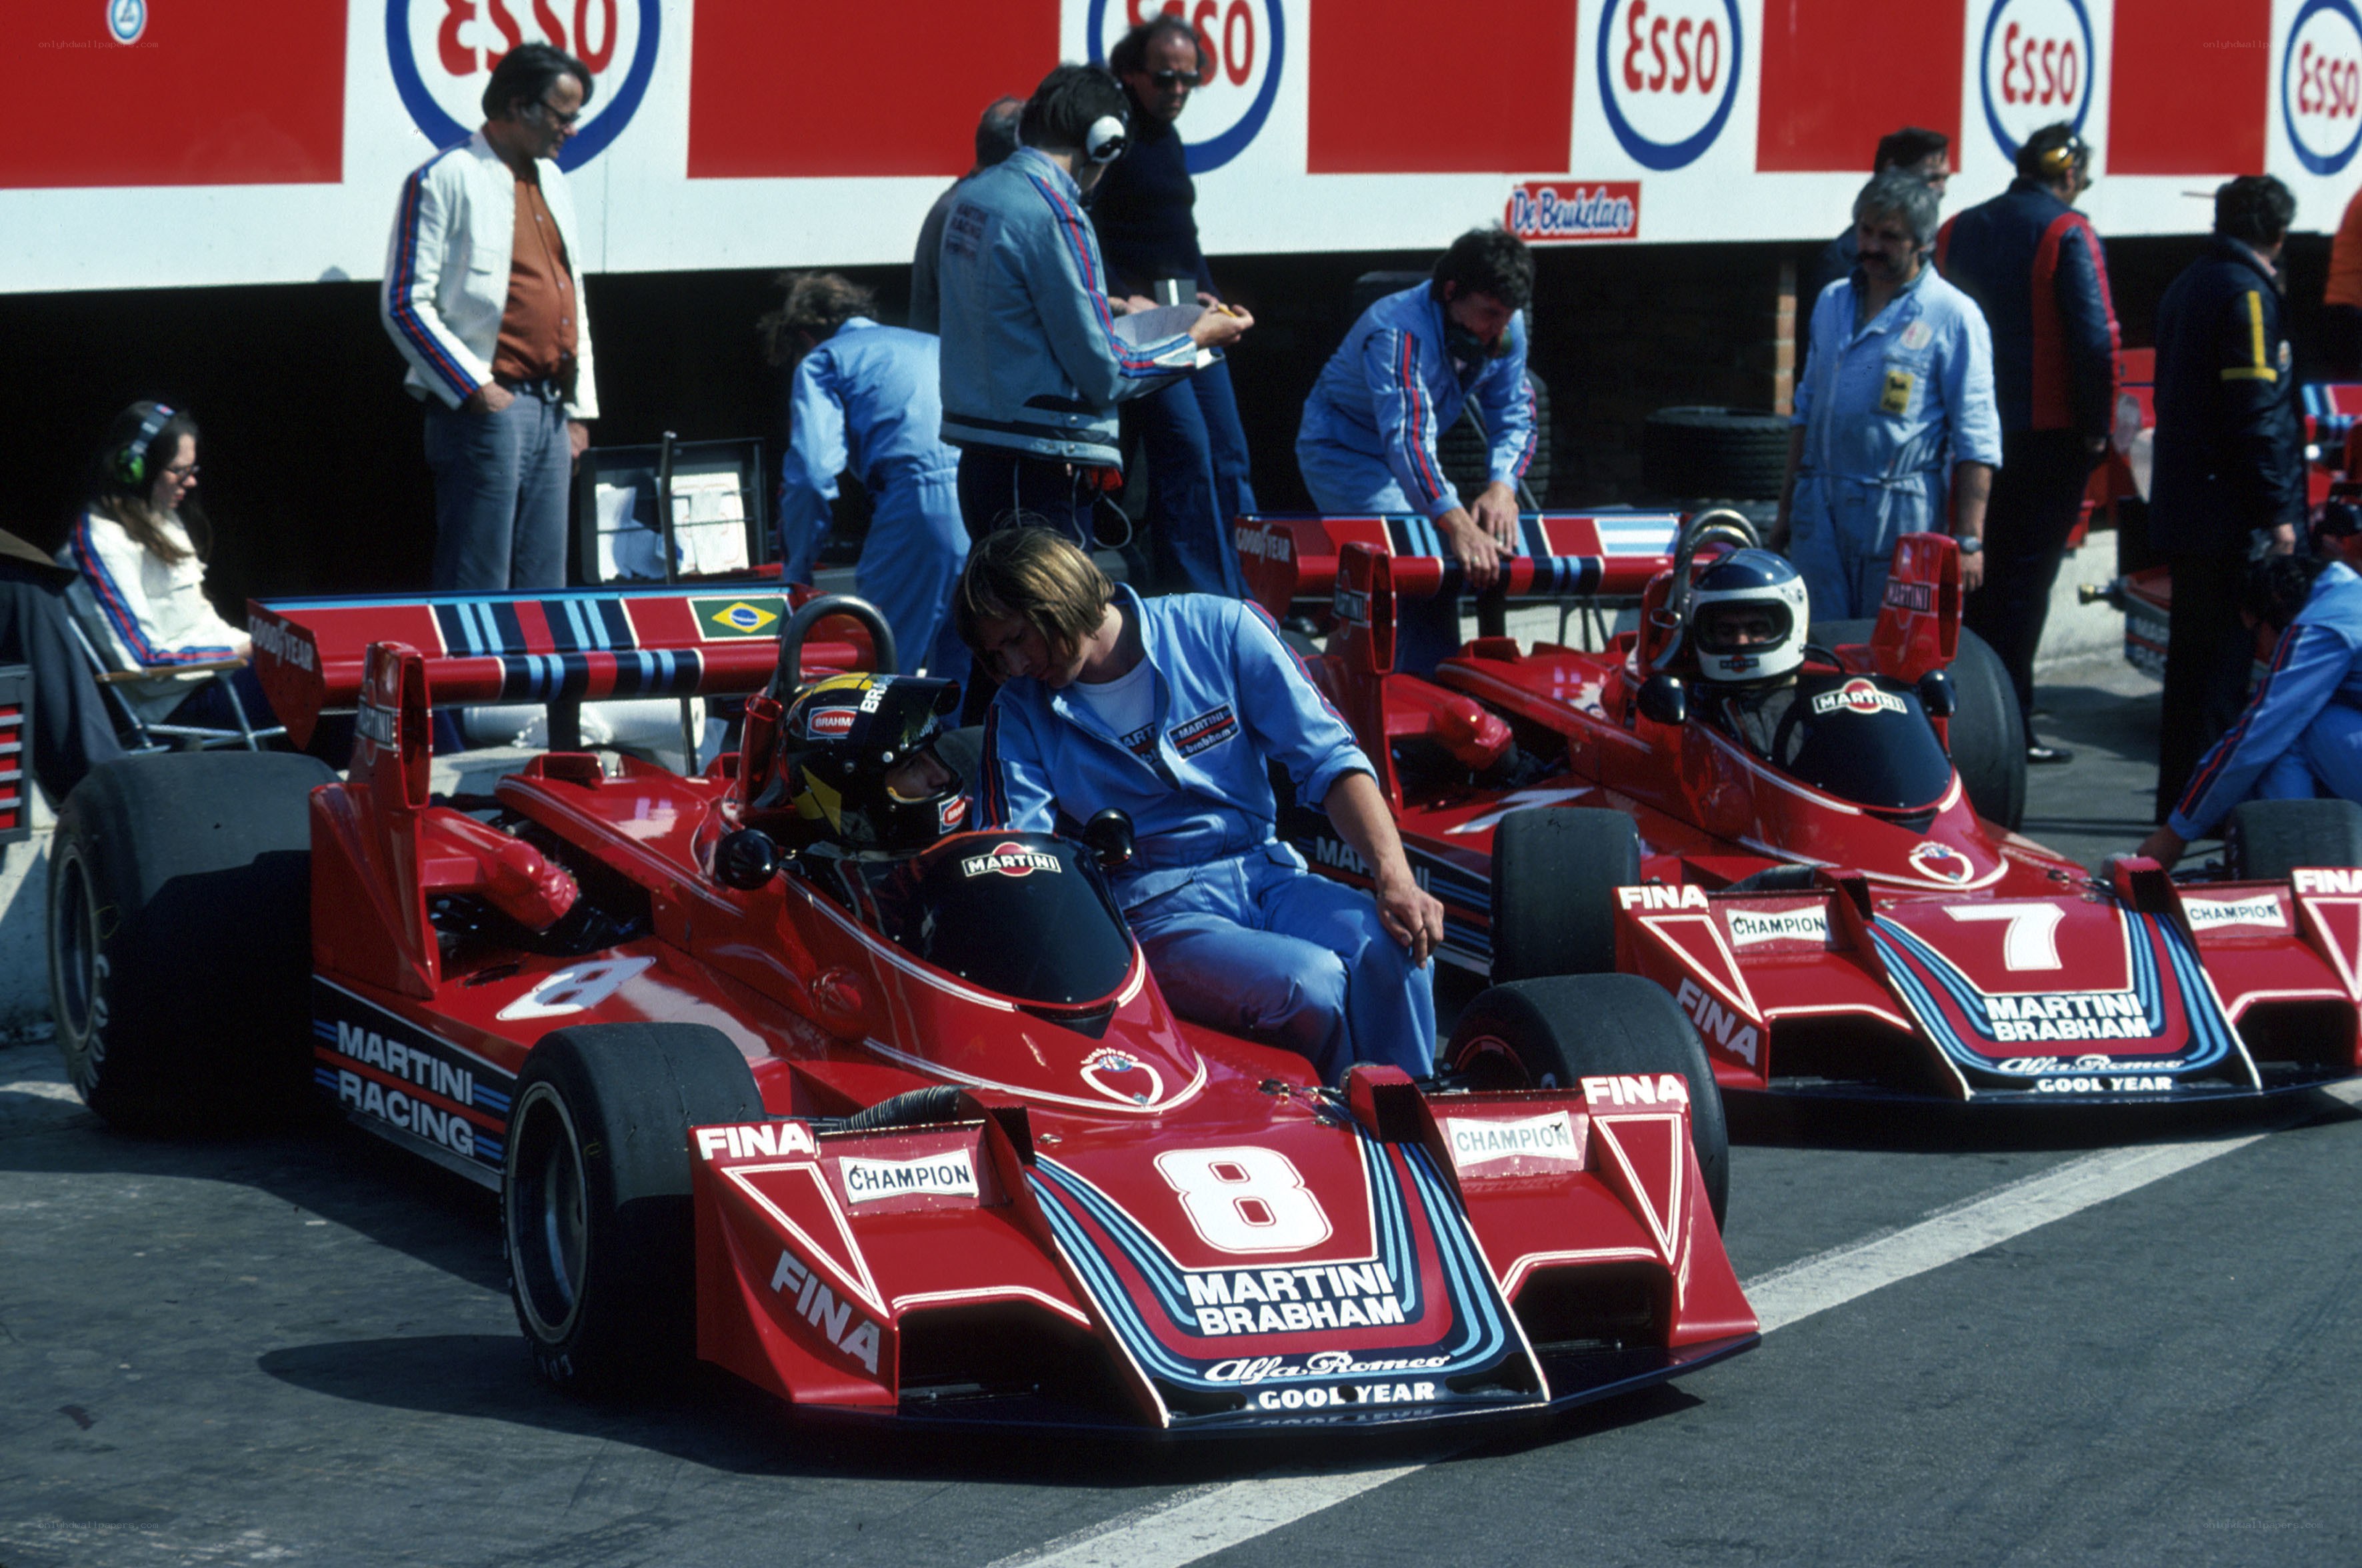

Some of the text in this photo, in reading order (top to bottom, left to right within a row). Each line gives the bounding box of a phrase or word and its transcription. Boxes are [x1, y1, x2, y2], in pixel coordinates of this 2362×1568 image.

[1513, 189, 1537, 231] De
[1889, 581, 1929, 611] MARTINI
[1819, 689, 1905, 709] MARTINI
[1178, 711, 1225, 739] MARTINI
[1185, 728, 1231, 754] brabham
[968, 854, 1057, 873] MARTINI
[1617, 885, 1709, 910] FINA
[2189, 903, 2278, 920] CHAMPION
[1732, 916, 1826, 935] CHAMPION
[1942, 903, 2065, 971] 7
[1983, 993, 2144, 1021] MARTINI
[1676, 977, 1759, 1067] FINA
[1991, 1017, 2152, 1042] BRABHAM
[337, 1021, 473, 1107] MARTINI
[1581, 1075, 1689, 1105] FINA
[2109, 1076, 2173, 1091] YEAR
[338, 1069, 475, 1158] RACING
[695, 1123, 813, 1161] FINA
[1456, 1123, 1570, 1151] CHAMPION
[848, 1163, 971, 1192] CHAMPION
[1153, 1146, 1333, 1253] 8
[1183, 1263, 1394, 1306] MARTINI
[769, 1249, 881, 1375] FINA
[1195, 1295, 1405, 1336] BRABHAM
[1204, 1350, 1451, 1385] Alfa Romeo
[1355, 1381, 1435, 1404] YEAR
